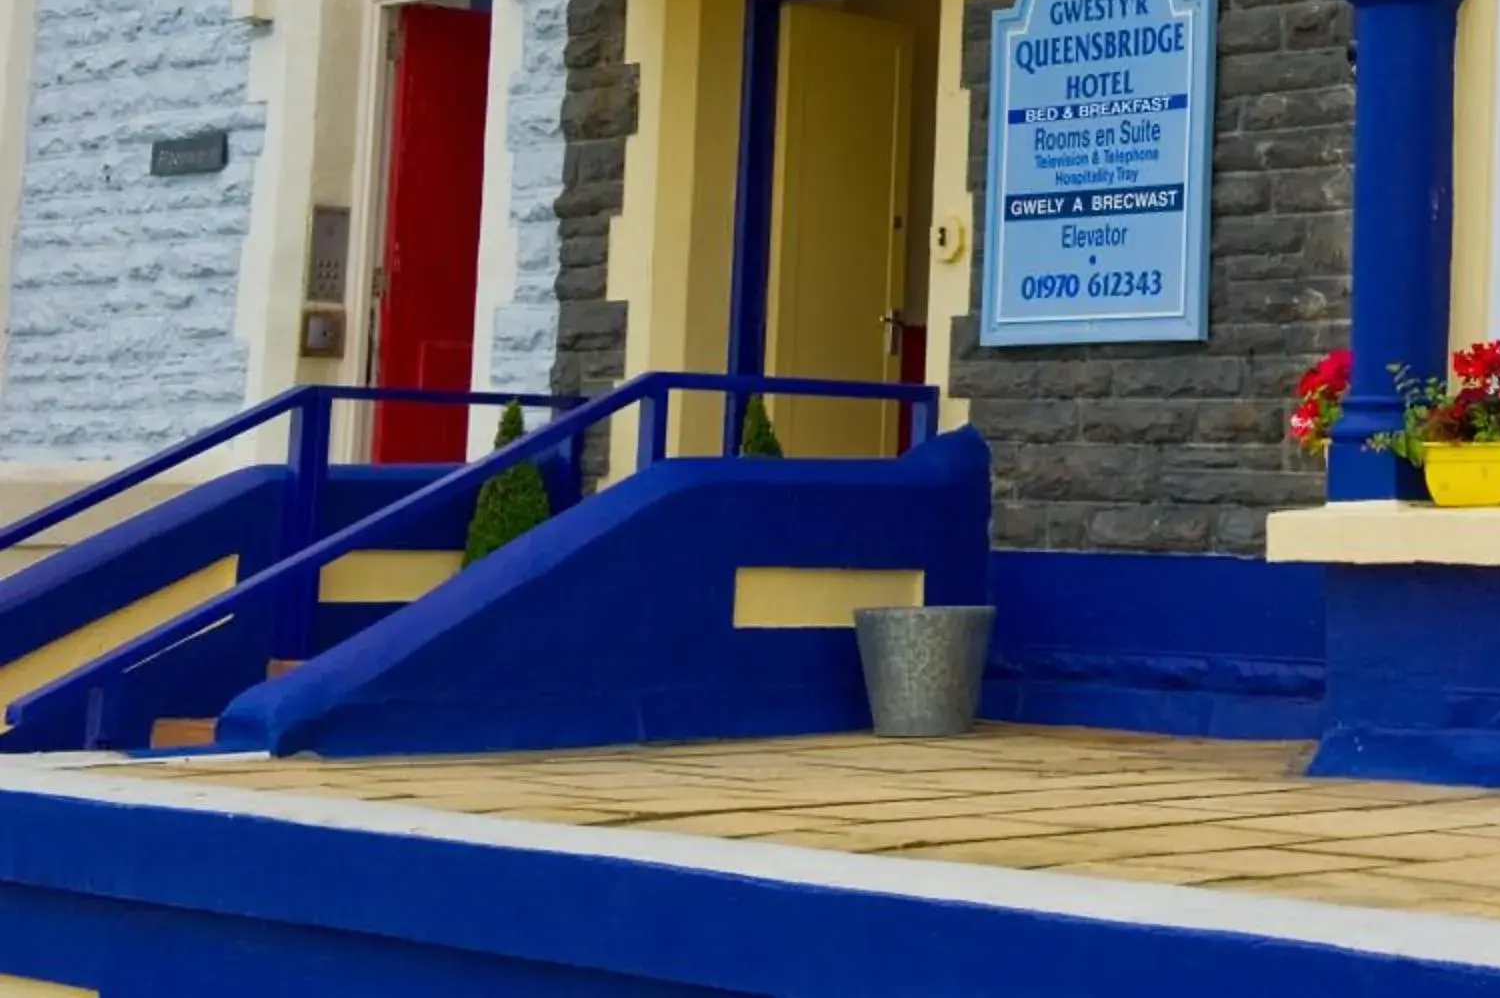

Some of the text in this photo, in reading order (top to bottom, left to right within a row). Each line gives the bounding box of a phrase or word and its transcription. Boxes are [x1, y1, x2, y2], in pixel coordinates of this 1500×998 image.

[1015, 22, 1185, 75] QUEENSBRIDGE
[1066, 69, 1135, 100] HOTEL
[1025, 97, 1171, 123] BED & BREAKFAST
[1034, 120, 1161, 151] Rooms en Suite
[1034, 148, 1160, 169] Television & Telephone
[1055, 165, 1140, 186] Hospitality Tray
[1011, 190, 1179, 216] GWELY A BRECWAST
[1061, 223, 1129, 249] Elevator
[1021, 269, 1163, 300] 01970 612343
